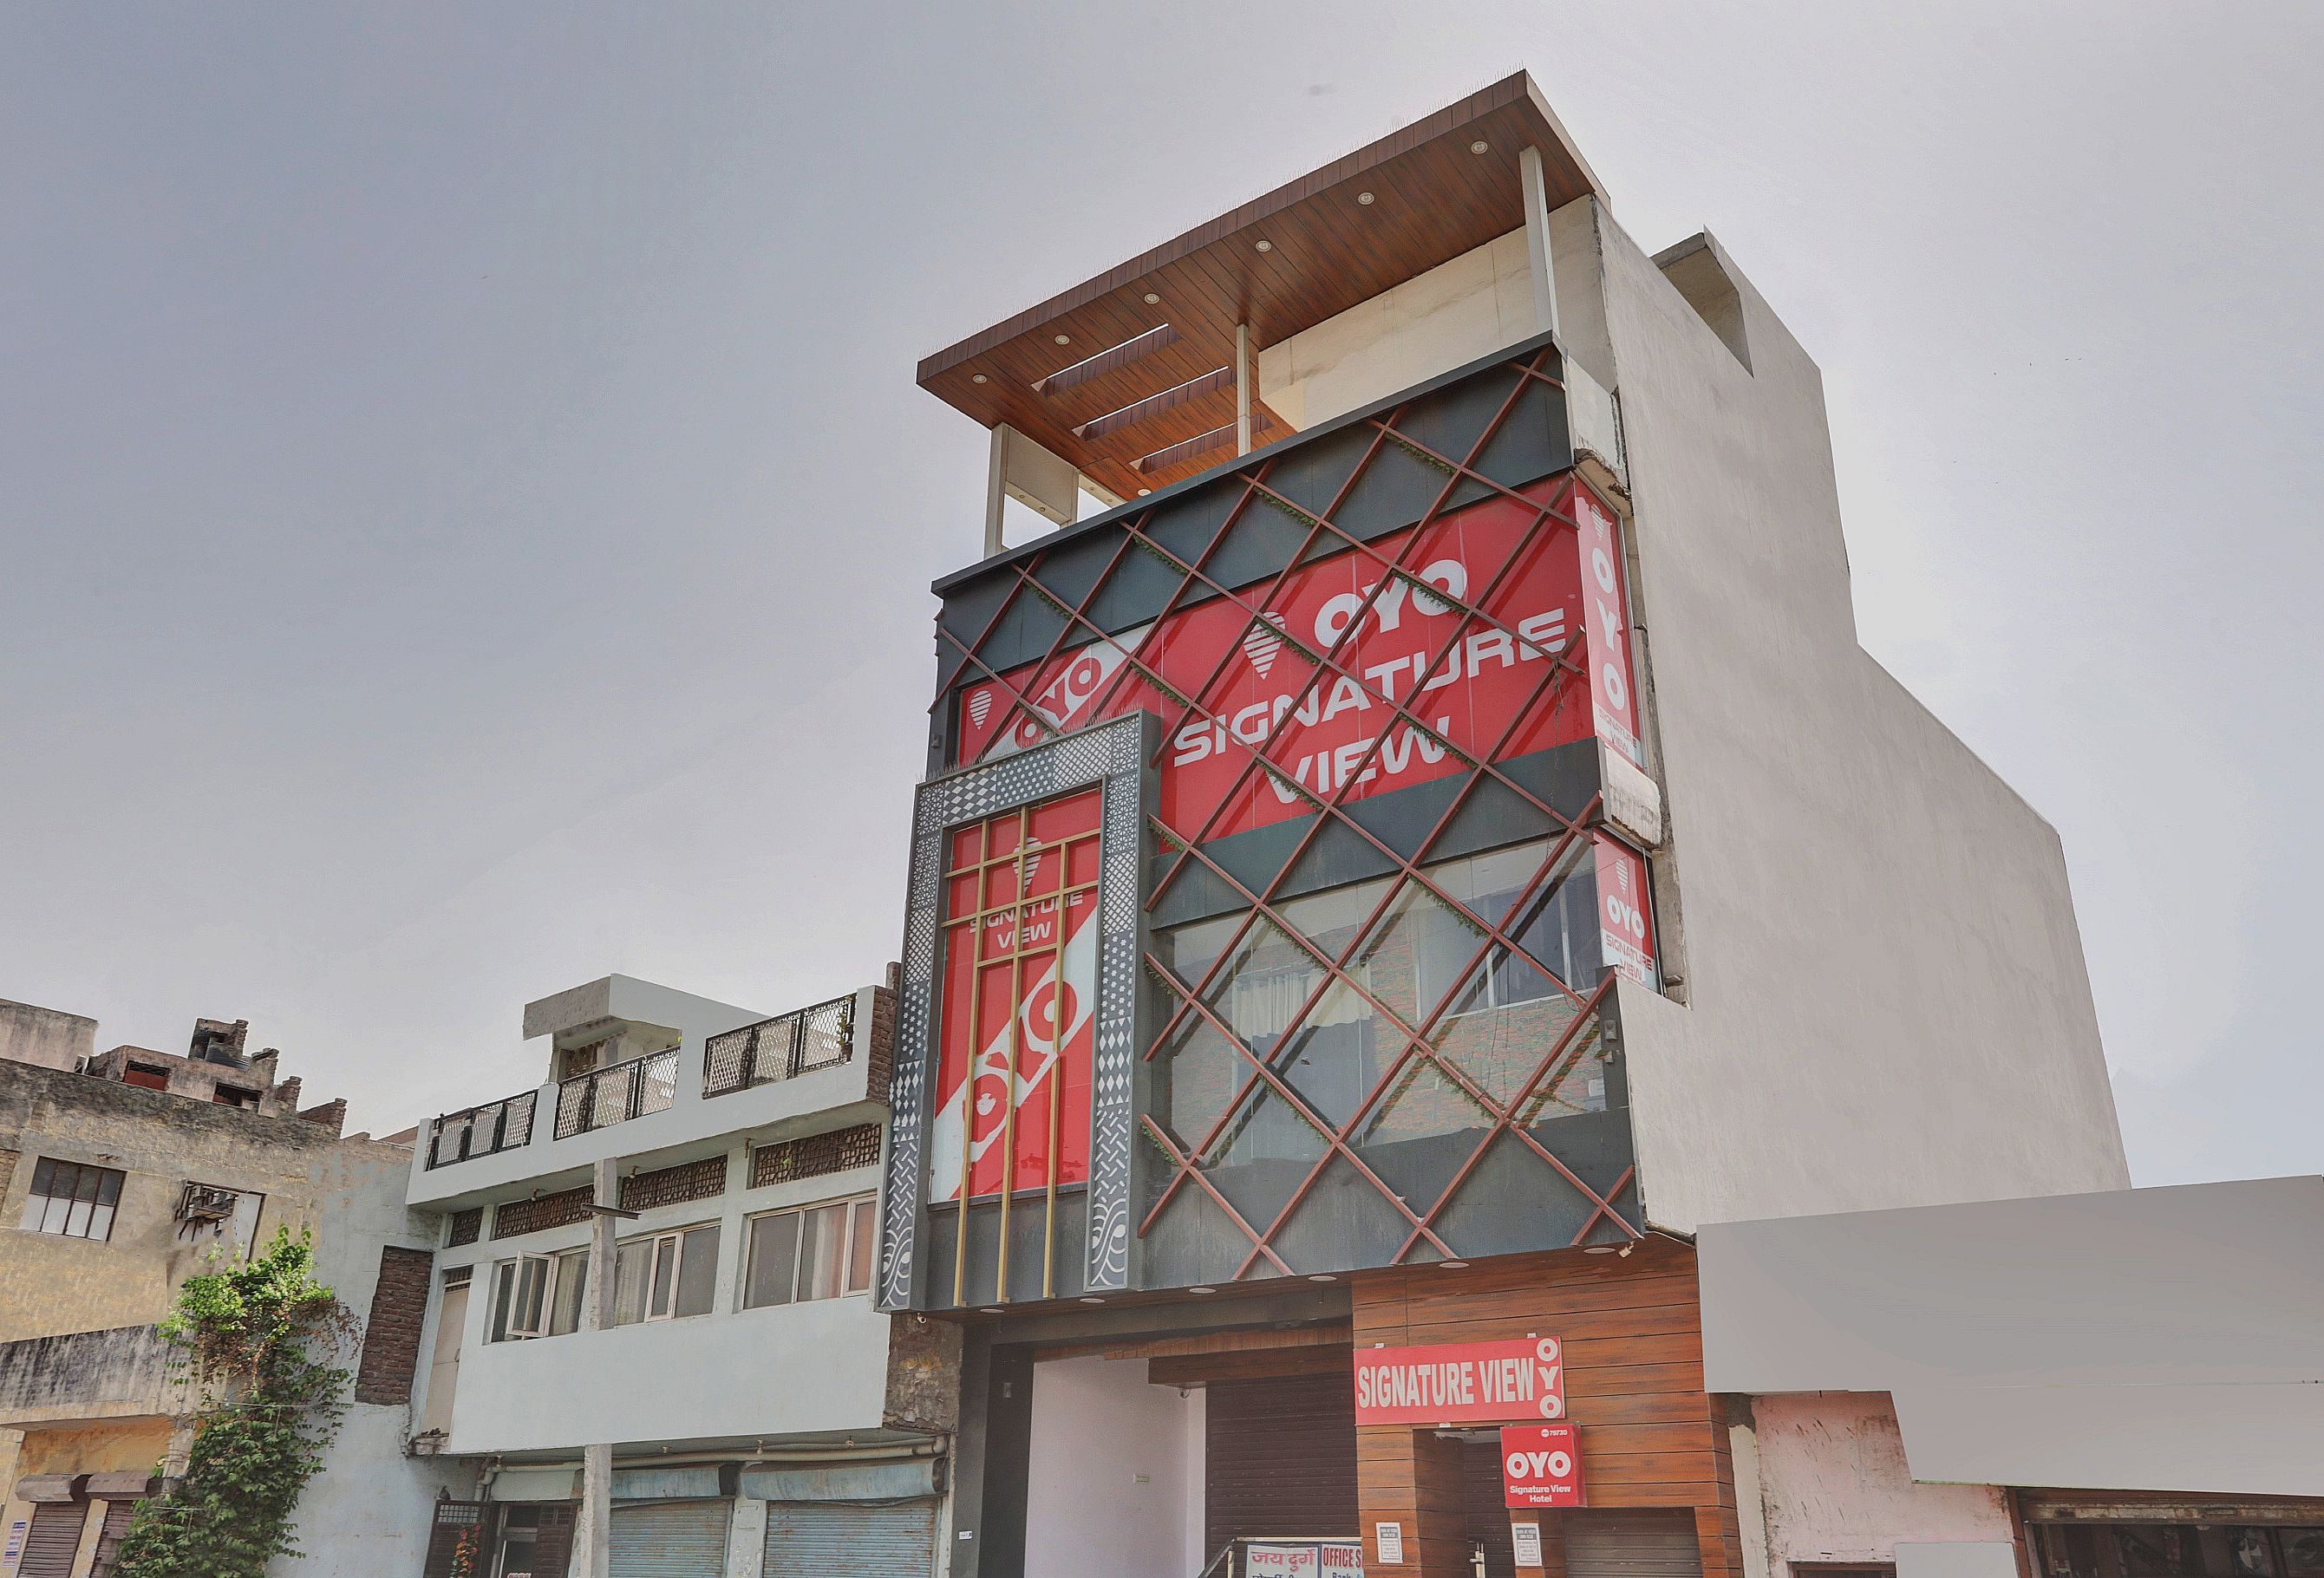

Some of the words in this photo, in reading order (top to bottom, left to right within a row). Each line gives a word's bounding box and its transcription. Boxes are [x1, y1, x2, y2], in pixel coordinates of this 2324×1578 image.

[1315, 559, 1468, 649] OYO
[1590, 547, 1625, 711] OYO
[1015, 657, 1102, 750] OYO
[1173, 607, 1566, 768] SIGNATURE
[1263, 715, 1450, 805] VIEW
[997, 921, 1052, 949] VIEW
[1607, 894, 1645, 940] OYO
[1605, 933, 1653, 972] SIGNATURE
[1357, 1360, 1475, 1409] SIGNATURE
[1478, 1357, 1535, 1404] VIEW
[1536, 1338, 1562, 1419] OYO
[1506, 1450, 1571, 1479] OYO
[1510, 1484, 1550, 1496] Signature
[1550, 1484, 1571, 1493] View
[1529, 1494, 1552, 1503] Hotel
[1322, 1547, 1354, 1568] OFFICE
